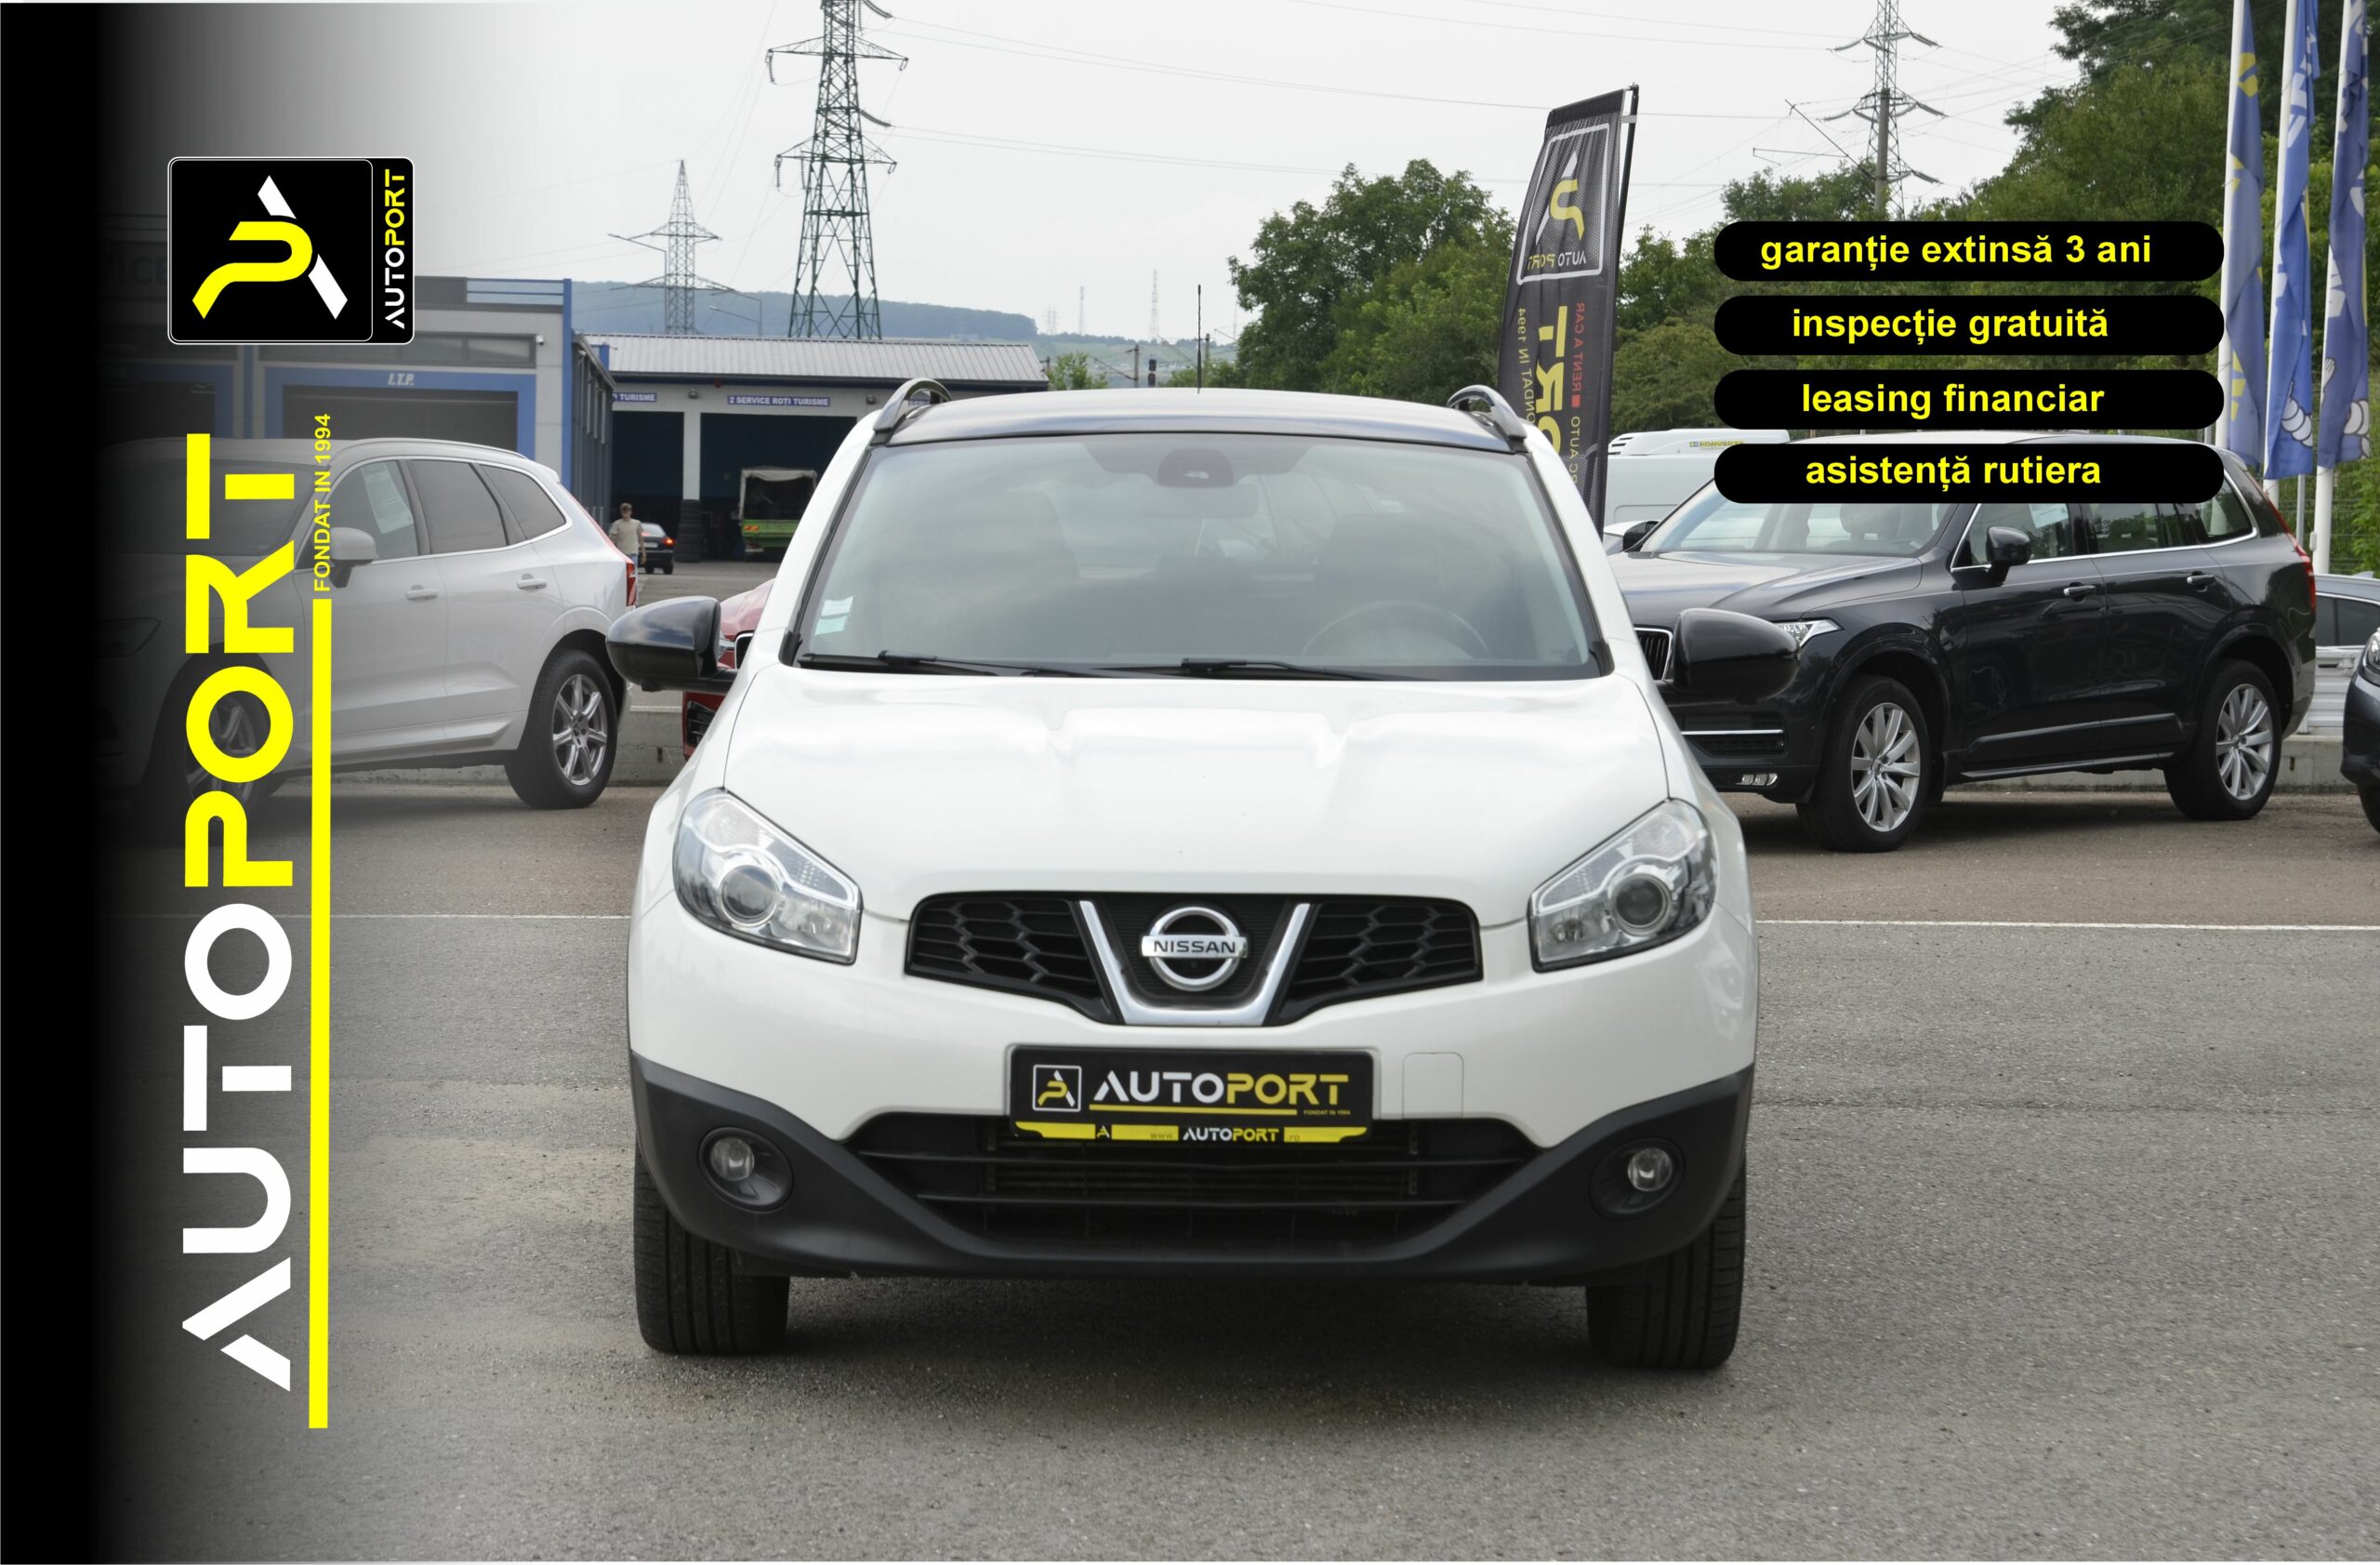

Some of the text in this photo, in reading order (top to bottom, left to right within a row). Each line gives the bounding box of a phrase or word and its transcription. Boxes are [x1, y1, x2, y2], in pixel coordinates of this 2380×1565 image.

[736, 396, 771, 405] SERVICE
[793, 397, 829, 405] TURISME
[1154, 940, 1236, 953] NISSAN
[1092, 1070, 1349, 1105] AUTOPORT
[1183, 1127, 1279, 1142] AUTOPORT
